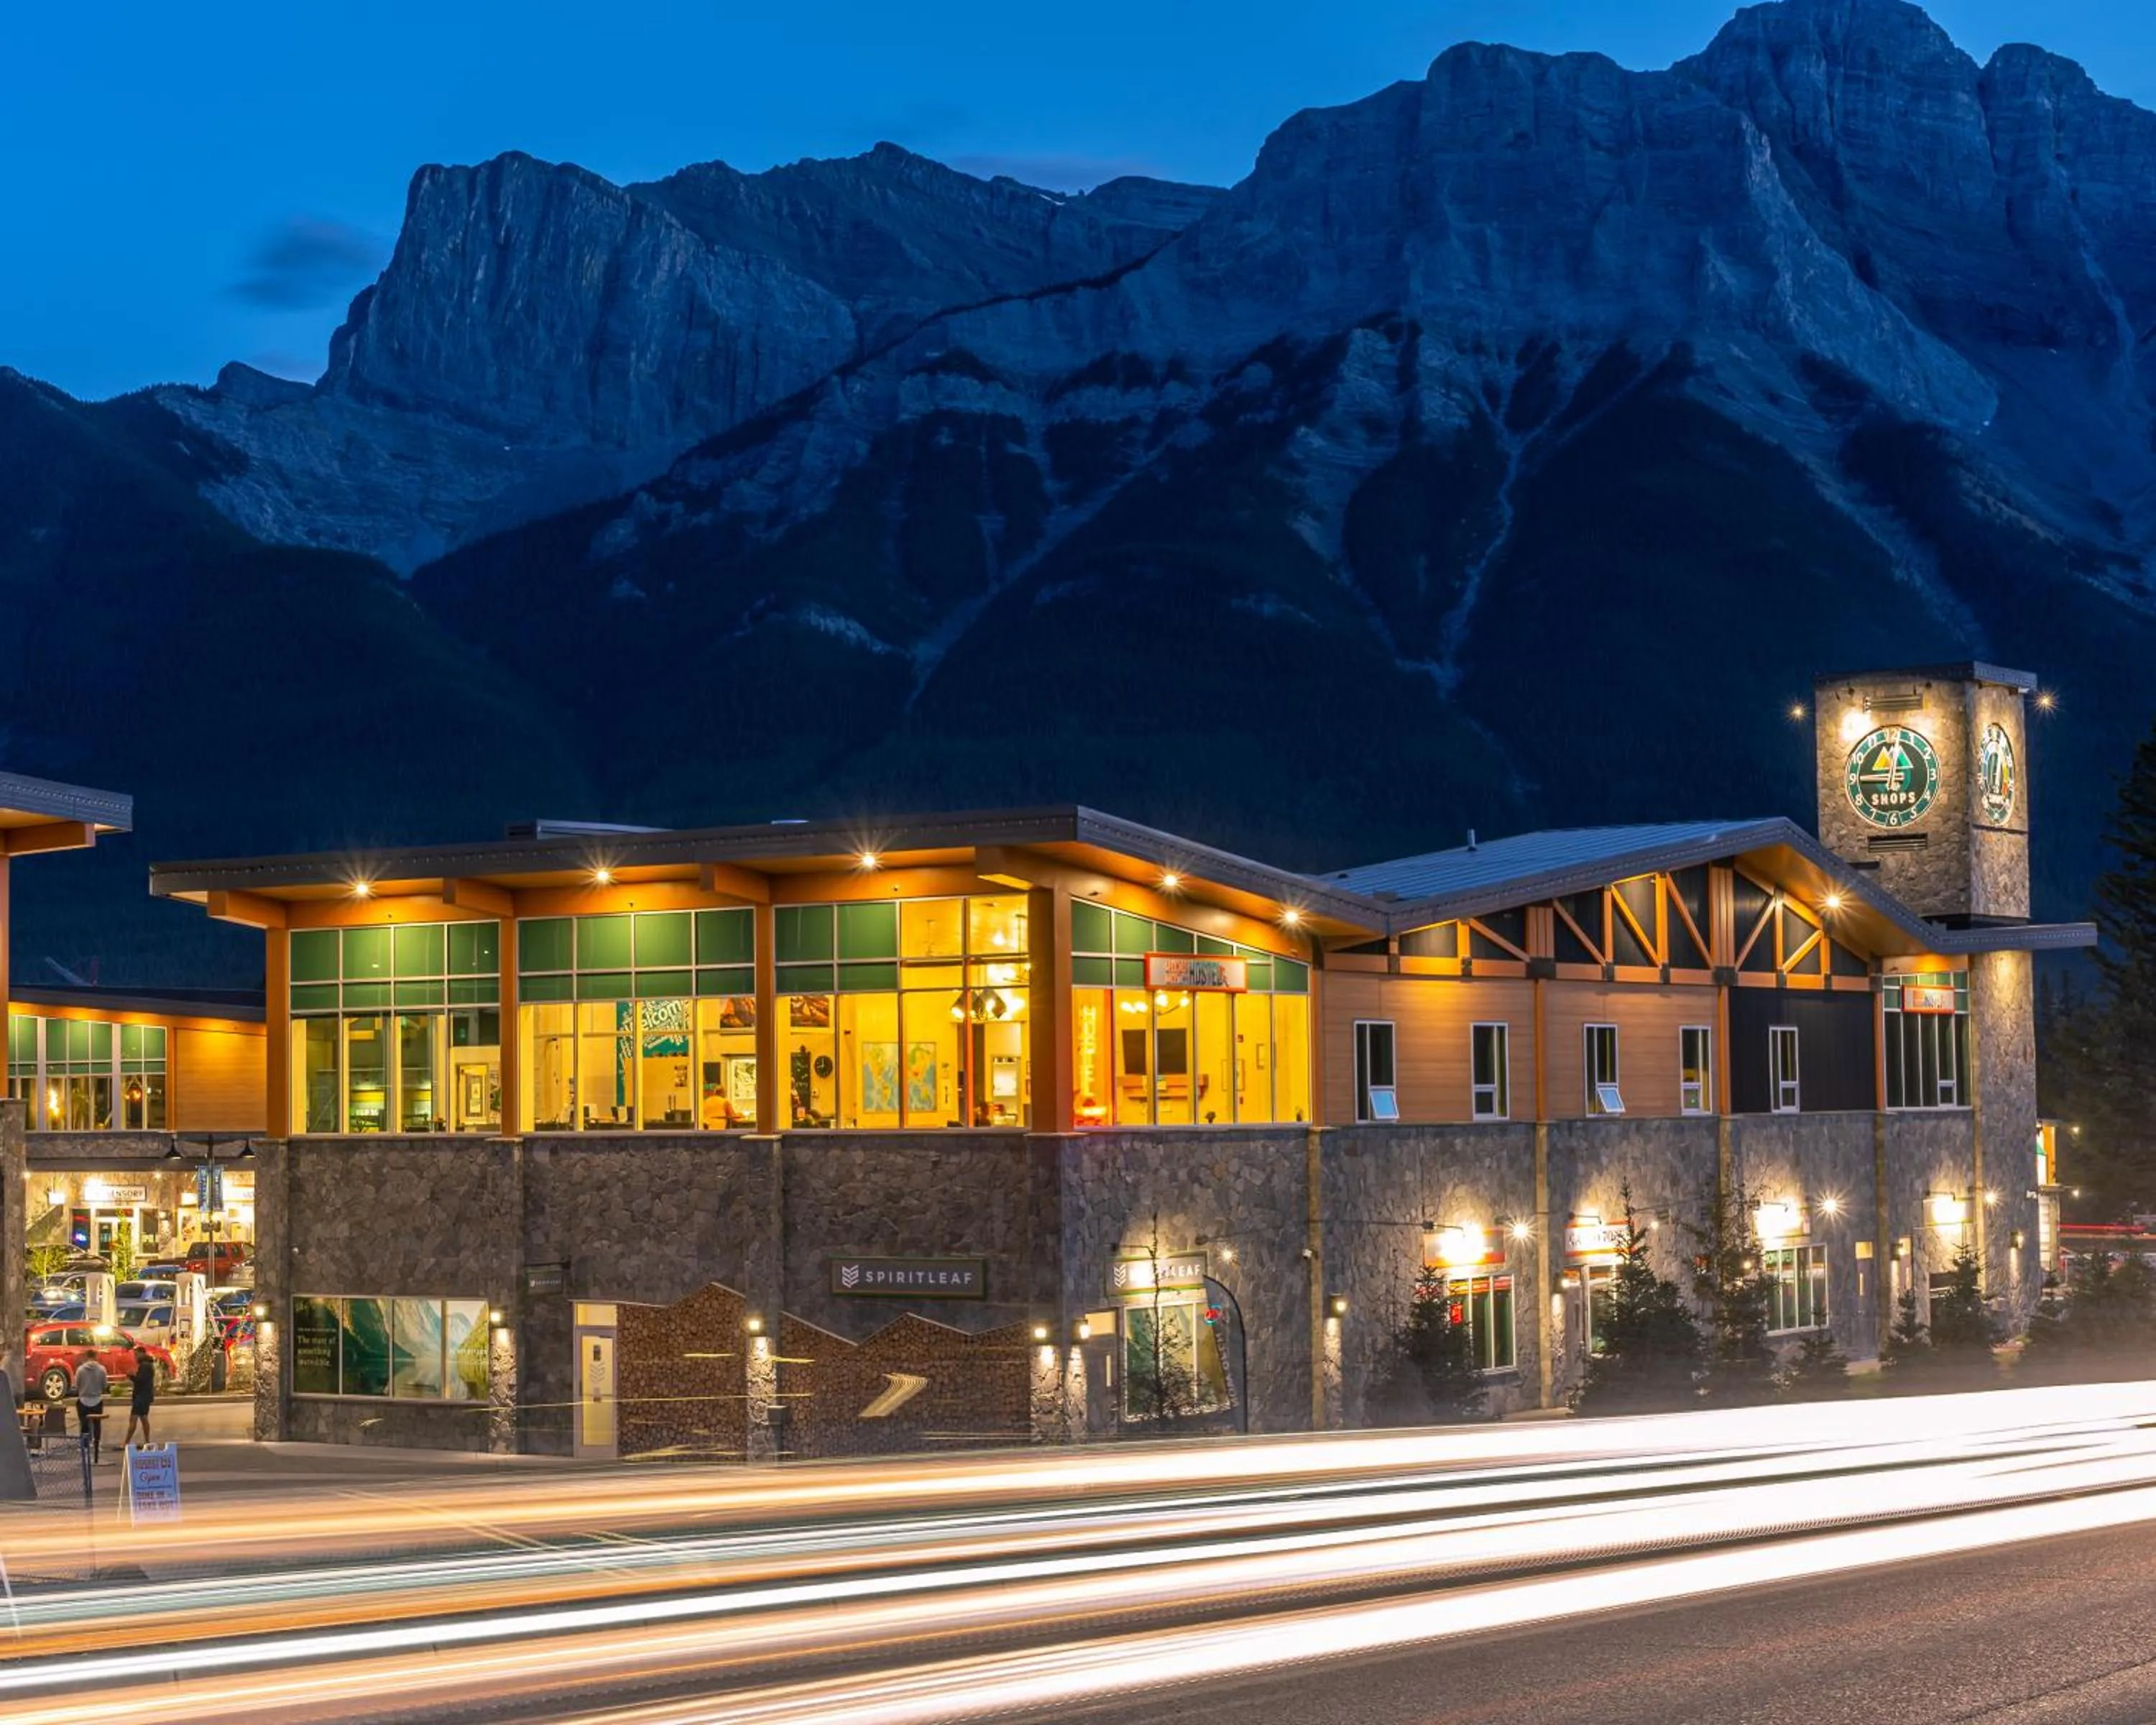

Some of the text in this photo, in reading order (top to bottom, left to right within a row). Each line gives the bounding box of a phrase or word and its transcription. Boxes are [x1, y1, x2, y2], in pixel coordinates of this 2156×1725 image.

[1885, 728, 1897, 740] 12
[1853, 753, 1864, 763] 10
[1924, 748, 1932, 760] 2
[1849, 773, 1856, 785] 9
[1930, 769, 1937, 781] 3
[1855, 794, 1863, 806] 8
[1871, 791, 1915, 805] SHOPS
[1924, 791, 1930, 801] 4
[1889, 813, 1897, 825] 6
[1909, 808, 1917, 819] 5
[865, 1271, 972, 1284] SPIRITLEAF
